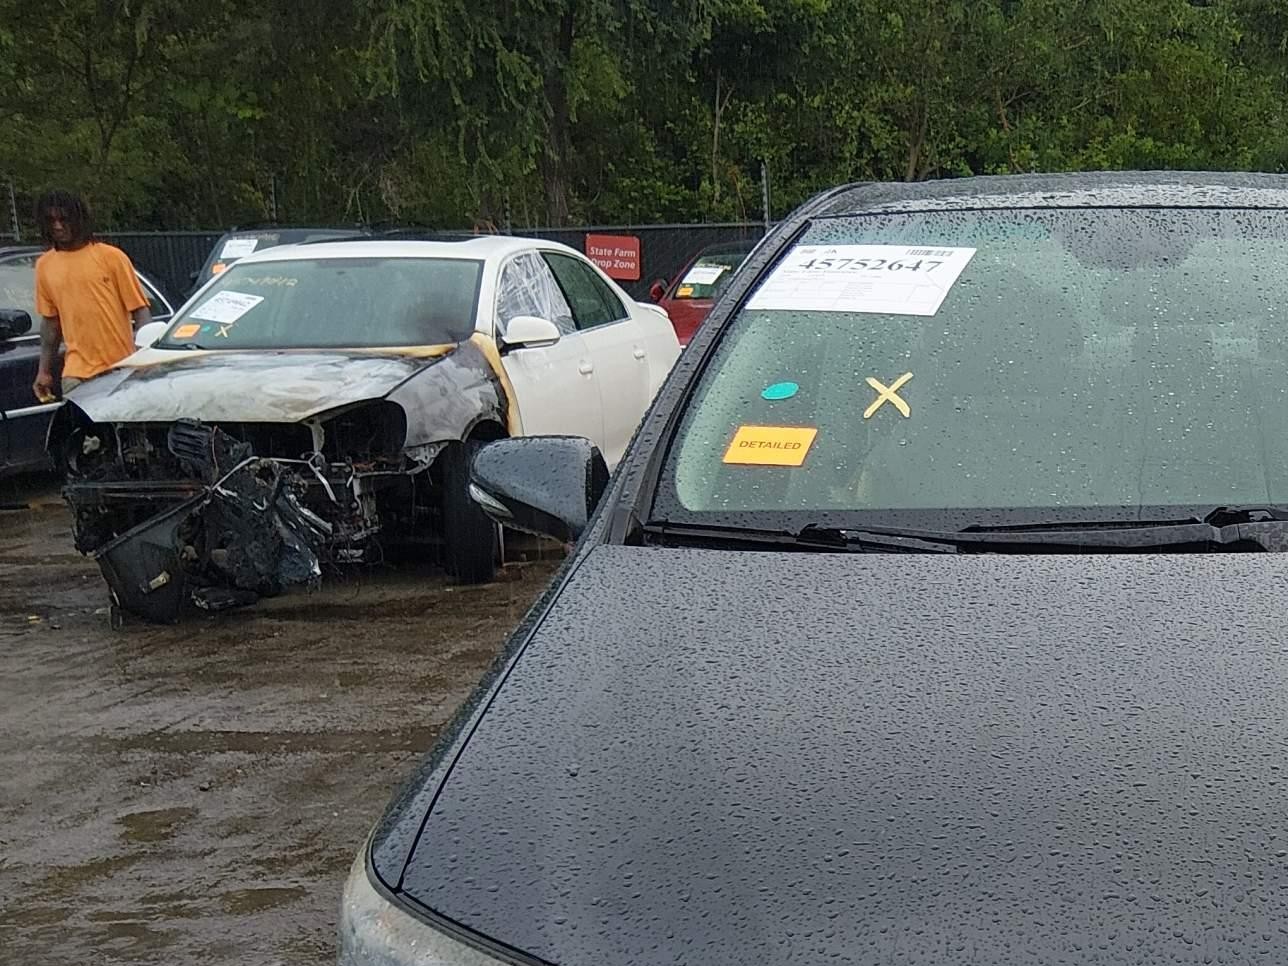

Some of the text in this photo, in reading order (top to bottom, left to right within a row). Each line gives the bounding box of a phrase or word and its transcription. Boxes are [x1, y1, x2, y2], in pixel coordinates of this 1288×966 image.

[590, 246, 636, 257] State Farm
[613, 259, 636, 269] Zone
[798, 258, 943, 273] 45752647
[739, 440, 802, 450] DETAILED
